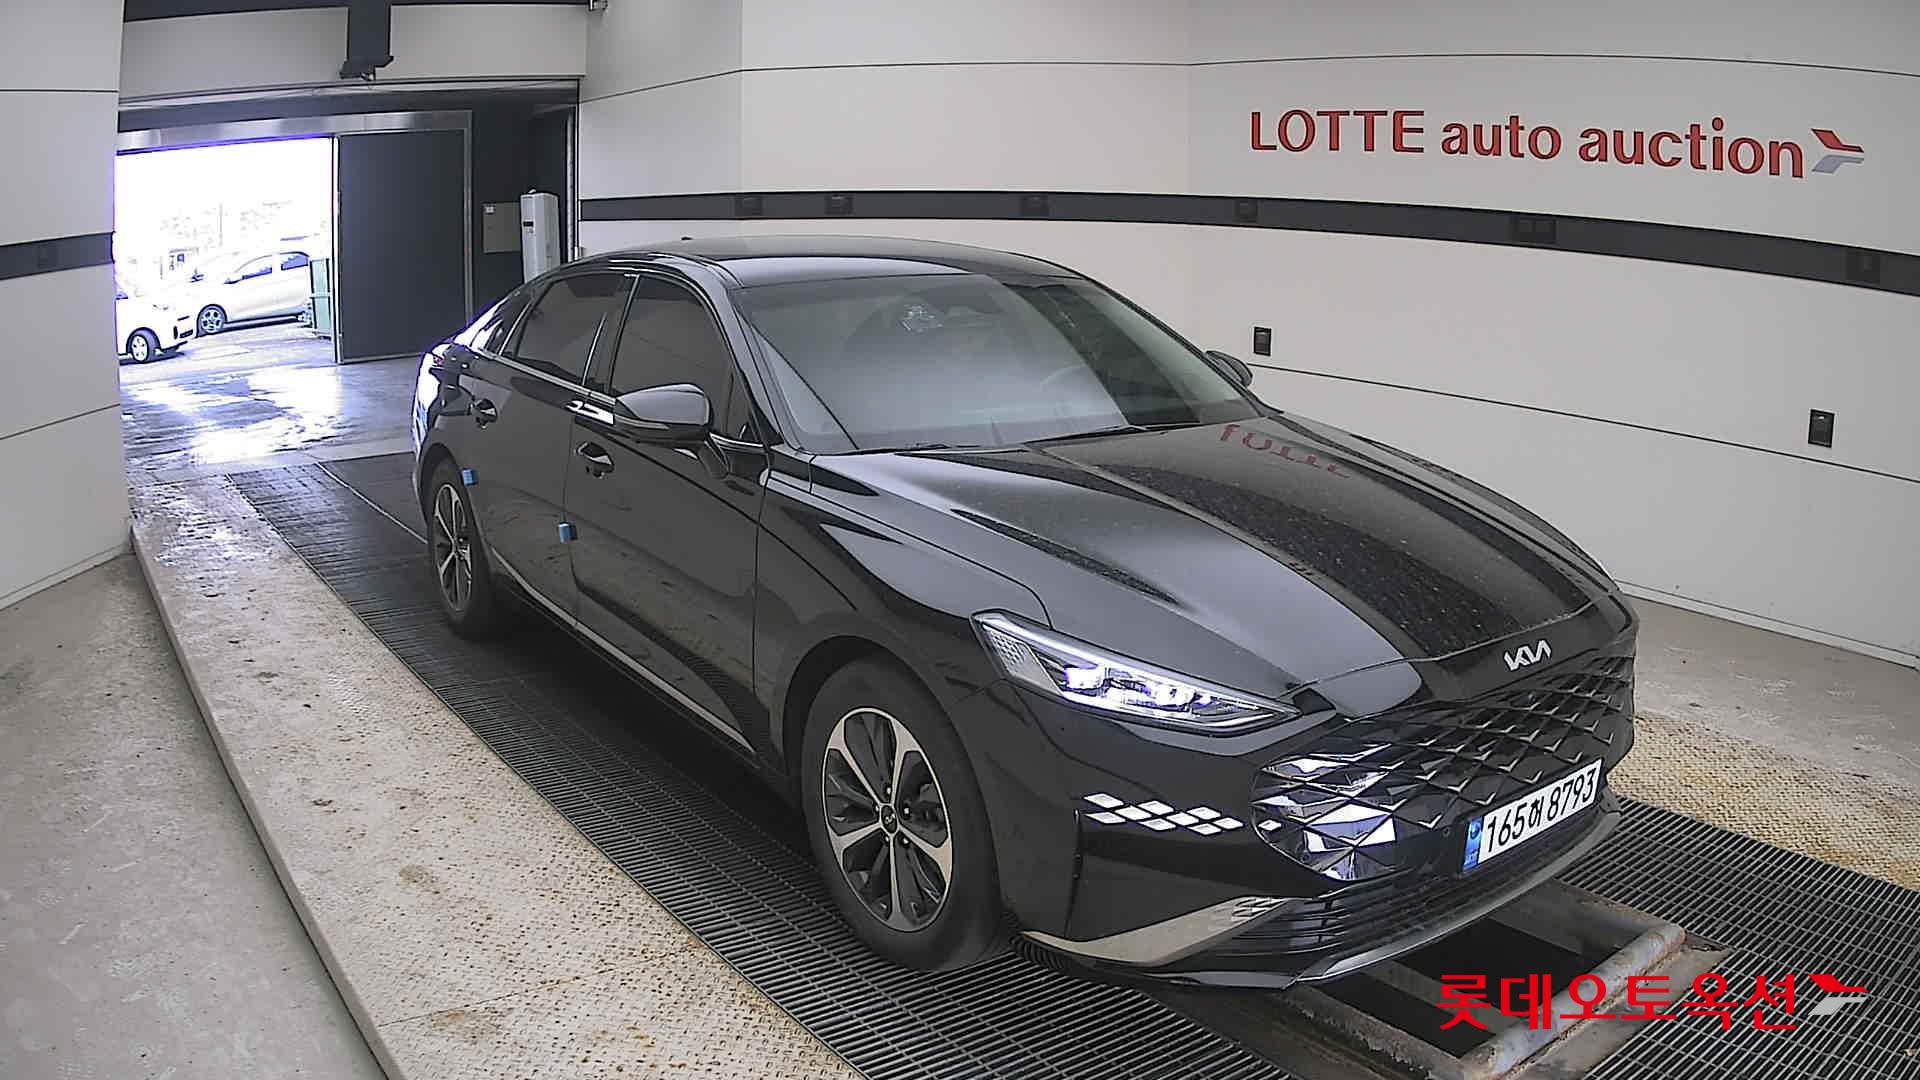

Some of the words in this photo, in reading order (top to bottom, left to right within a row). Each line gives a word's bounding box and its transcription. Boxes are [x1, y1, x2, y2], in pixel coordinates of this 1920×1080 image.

[1250, 110, 1424, 152] LOTTE
[1441, 115, 1562, 159] auto
[1578, 116, 1804, 178] auction
[1503, 639, 1551, 671] KIA
